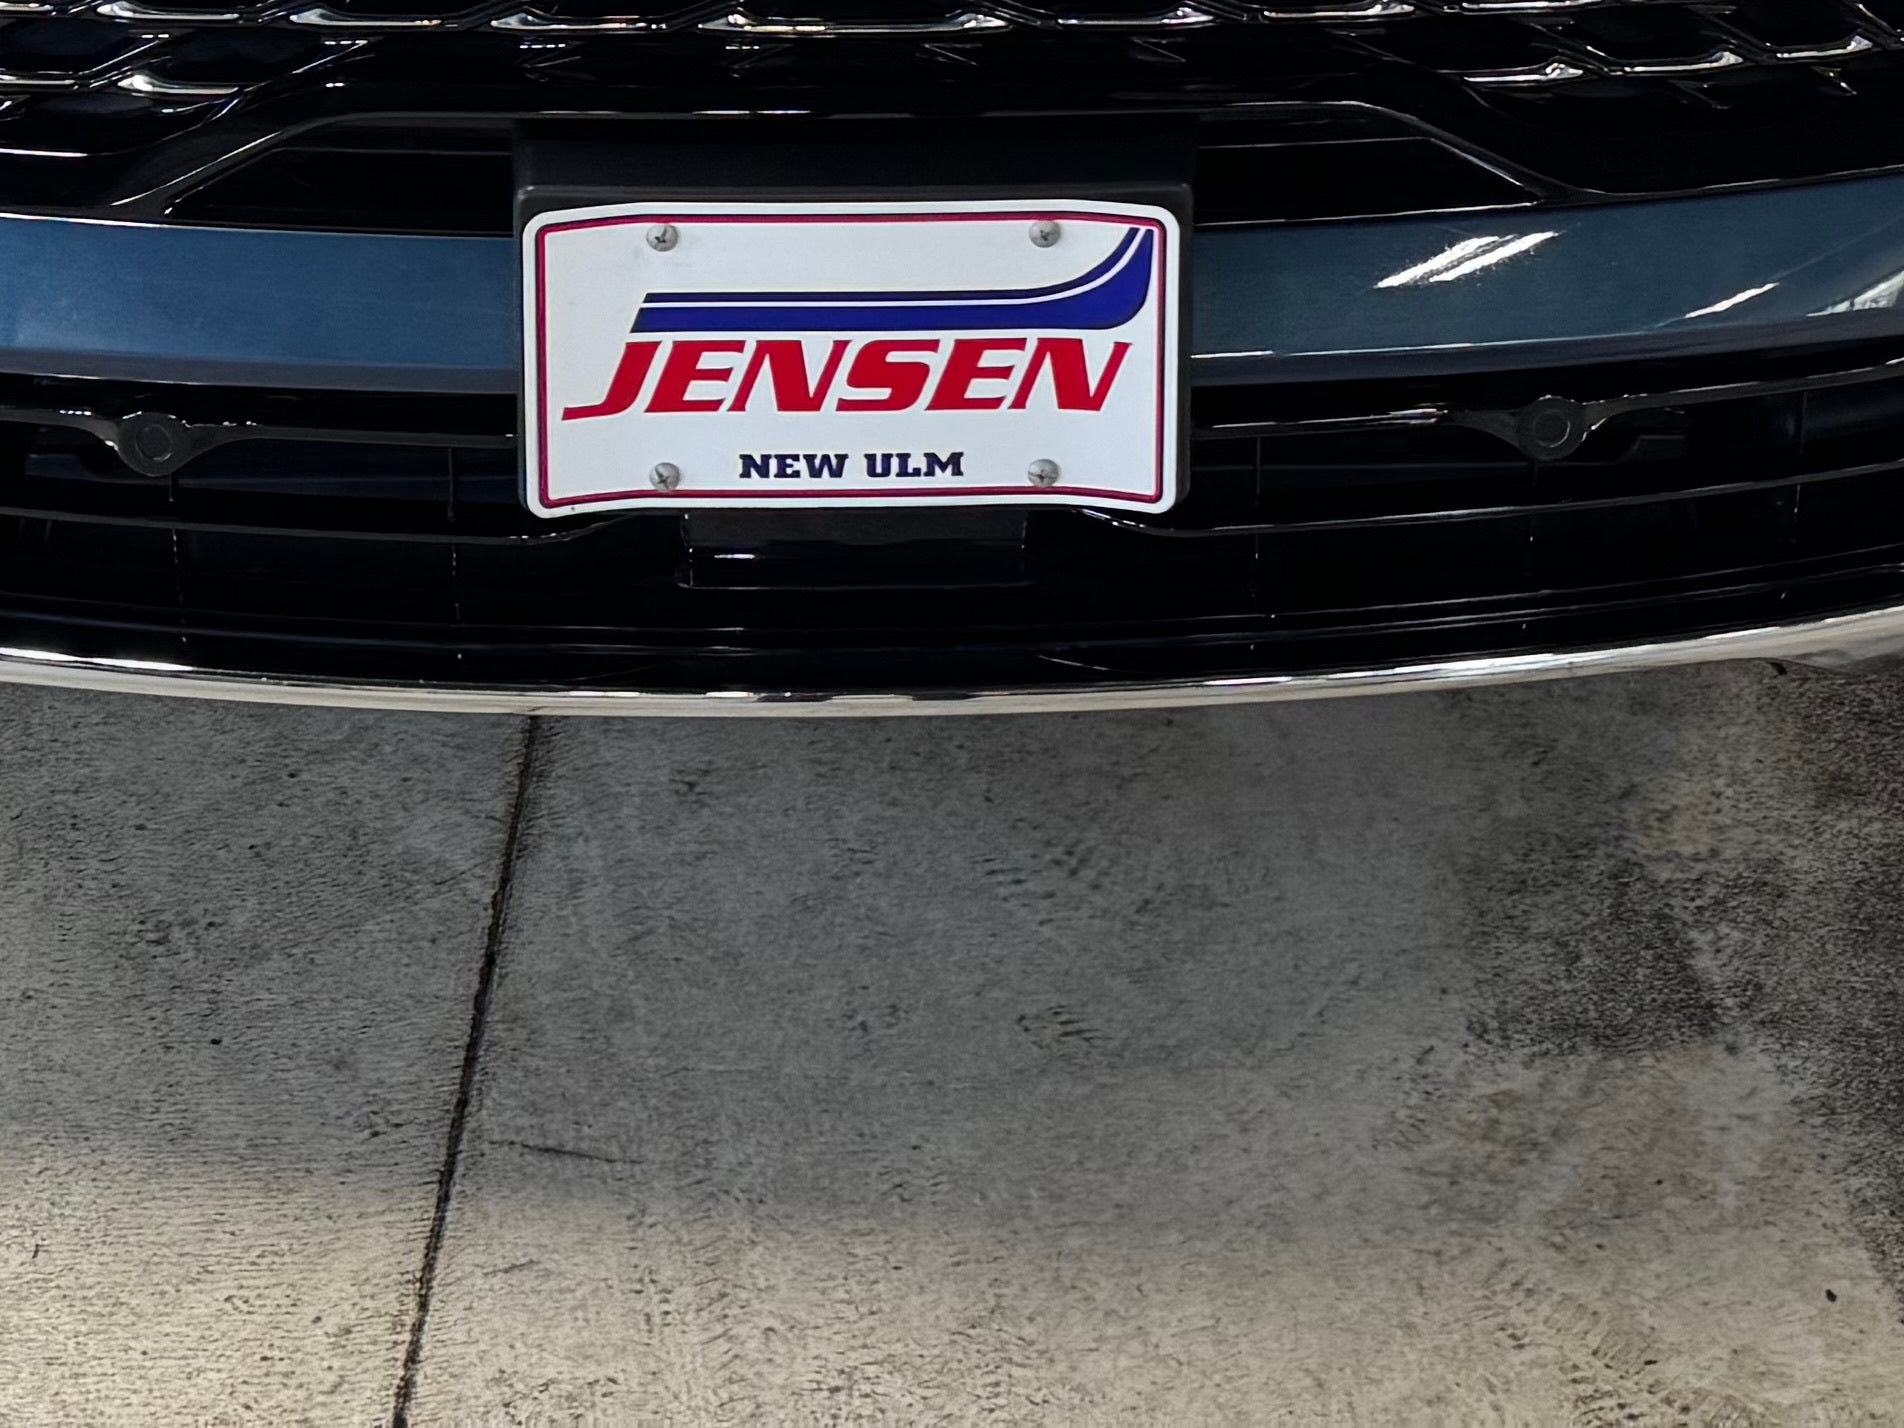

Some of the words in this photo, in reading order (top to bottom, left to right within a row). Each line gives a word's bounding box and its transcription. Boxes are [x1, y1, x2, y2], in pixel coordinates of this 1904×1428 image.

[562, 337, 1132, 421] JENSEN
[739, 453, 849, 479] NEW
[865, 452, 965, 478] ULM
